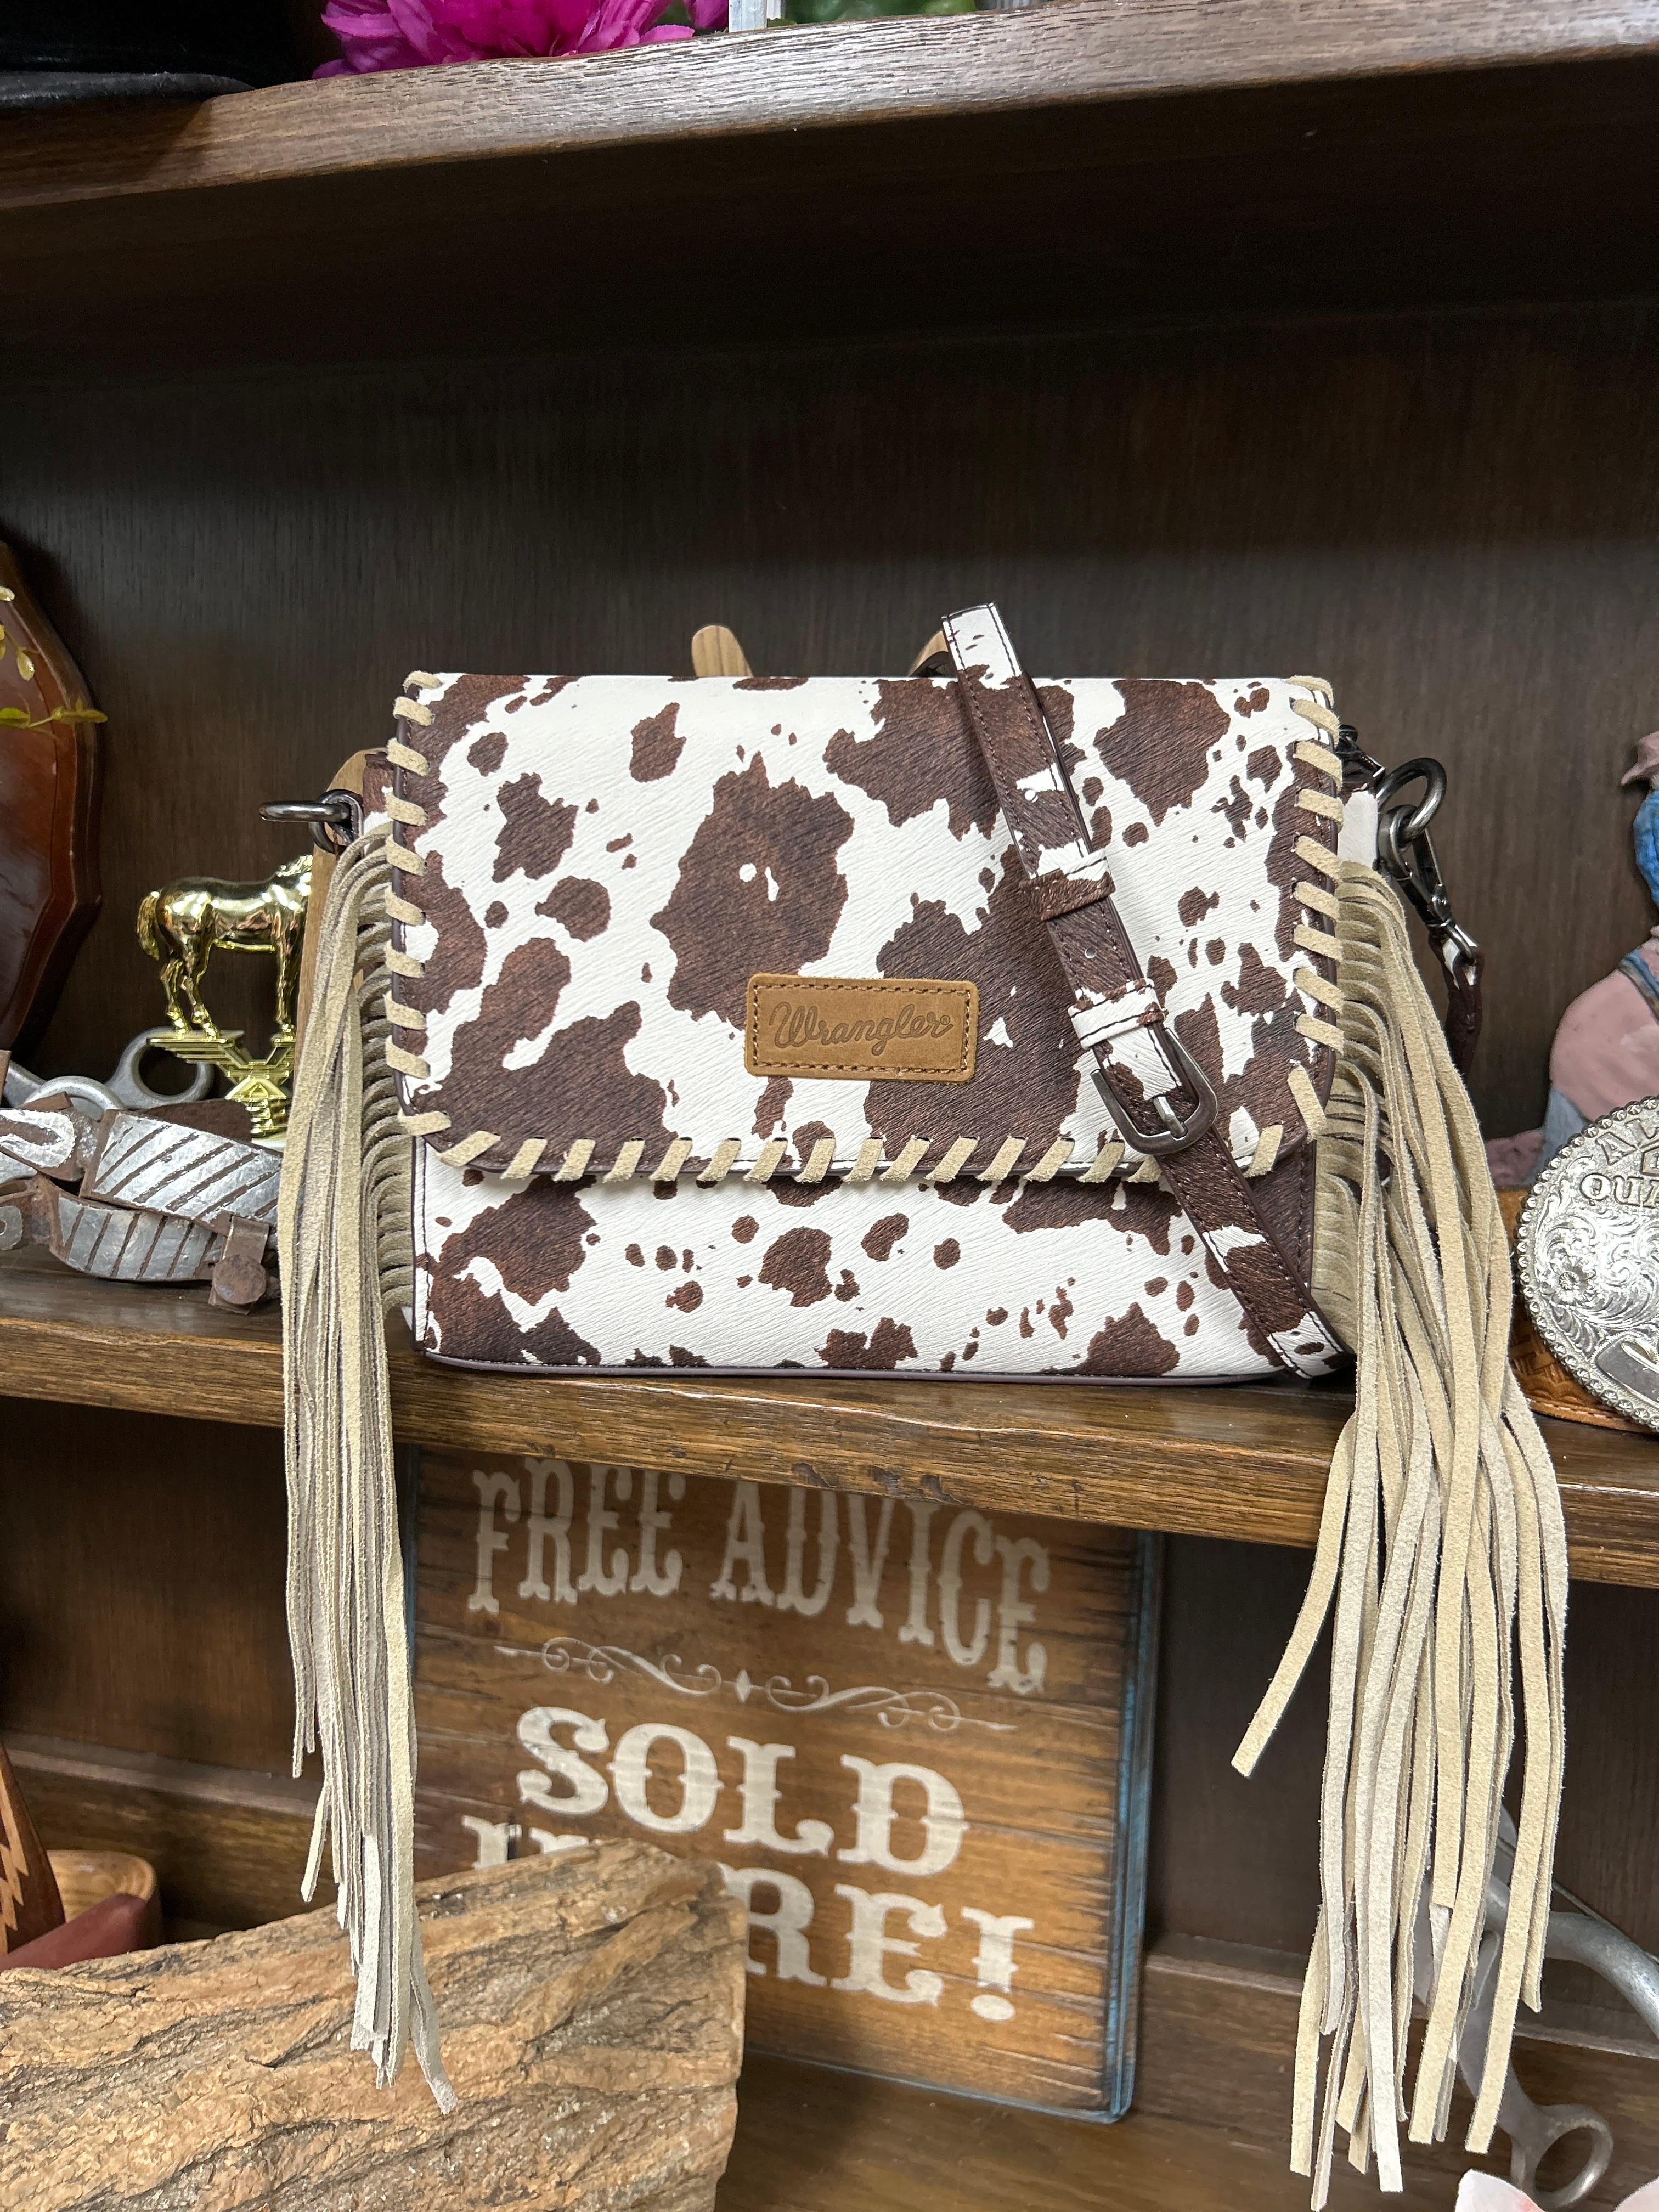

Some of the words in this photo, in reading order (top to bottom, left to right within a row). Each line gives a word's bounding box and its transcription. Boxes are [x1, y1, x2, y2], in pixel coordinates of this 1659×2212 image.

[467, 1457, 686, 1614] FREE
[710, 1481, 1048, 1695] ADVICE
[517, 1706, 969, 1876] SOLD
